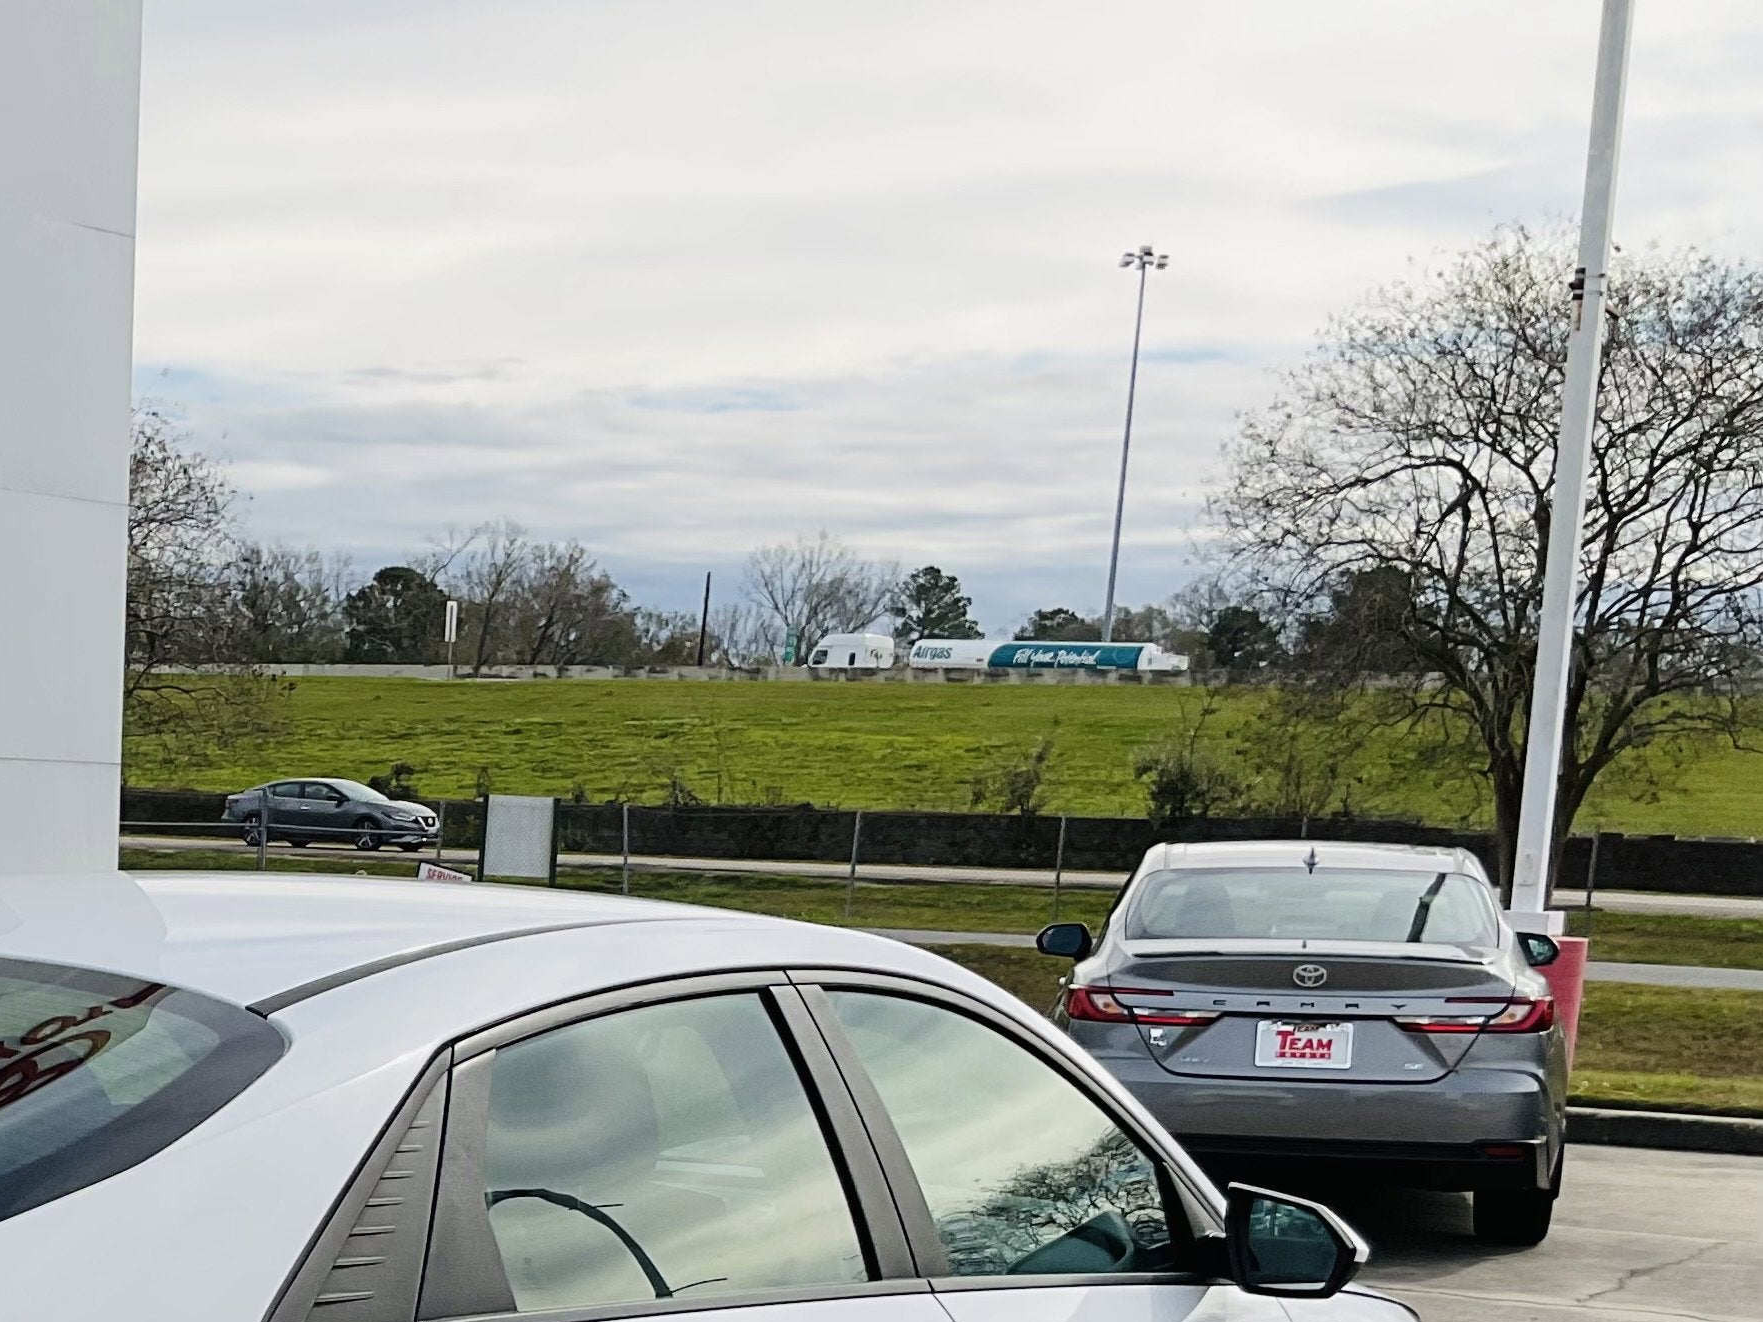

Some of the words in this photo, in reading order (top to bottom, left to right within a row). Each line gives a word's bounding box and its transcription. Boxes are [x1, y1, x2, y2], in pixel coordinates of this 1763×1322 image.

[913, 645, 952, 660] Airgas
[1212, 999, 1408, 1010] CAMRY
[1275, 1030, 1333, 1051] TEAM
